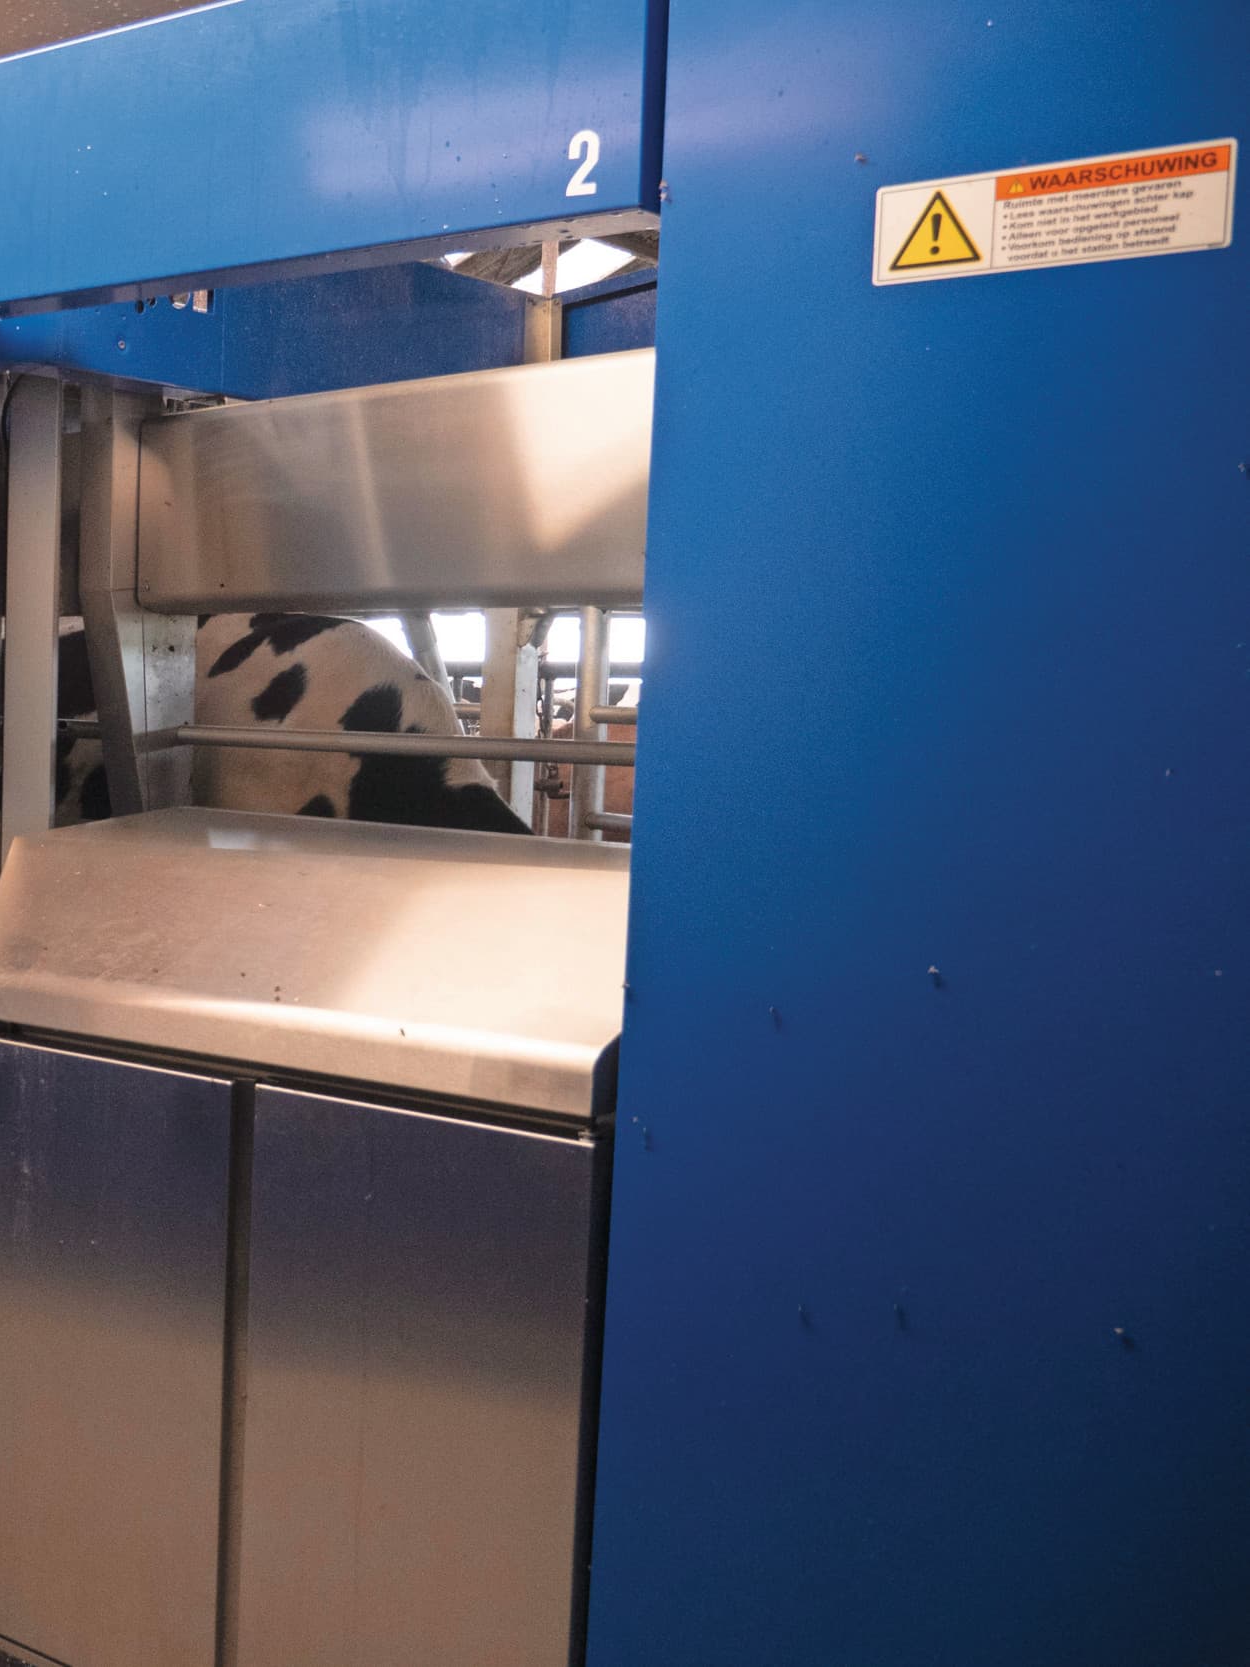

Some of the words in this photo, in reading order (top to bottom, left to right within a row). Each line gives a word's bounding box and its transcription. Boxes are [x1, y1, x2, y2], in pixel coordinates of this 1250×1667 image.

[566, 130, 600, 197] 2
[1029, 152, 1217, 190] WAARSCHUWING
[1003, 198, 1043, 209] Ruimte
[1047, 194, 1069, 204] met
[1072, 188, 1128, 200] meerdere
[1132, 180, 1182, 194] gevaren
[1010, 210, 1034, 220] Lees
[1038, 198, 1130, 216] waarschuwingen
[1134, 193, 1168, 204] achter
[1173, 190, 1194, 200] kap
[1008, 231, 1042, 241] Alleen
[1045, 228, 1069, 237] voor
[1073, 221, 1120, 234] opgeleid
[1123, 213, 1180, 228] personeel
[1009, 221, 1034, 230] Kom
[1037, 217, 1057, 226] niet
[1073, 213, 1091, 223] het
[1094, 205, 1158, 220] werkgebied
[1007, 251, 1048, 262] voordat
[1061, 247, 1078, 255] het
[1082, 243, 1119, 254] station
[1123, 236, 1170, 248] betreedt
[1008, 240, 1055, 251] Voorkom
[1058, 233, 1112, 246] bediening
[1116, 230, 1130, 240] op
[1134, 224, 1176, 237] afstand
